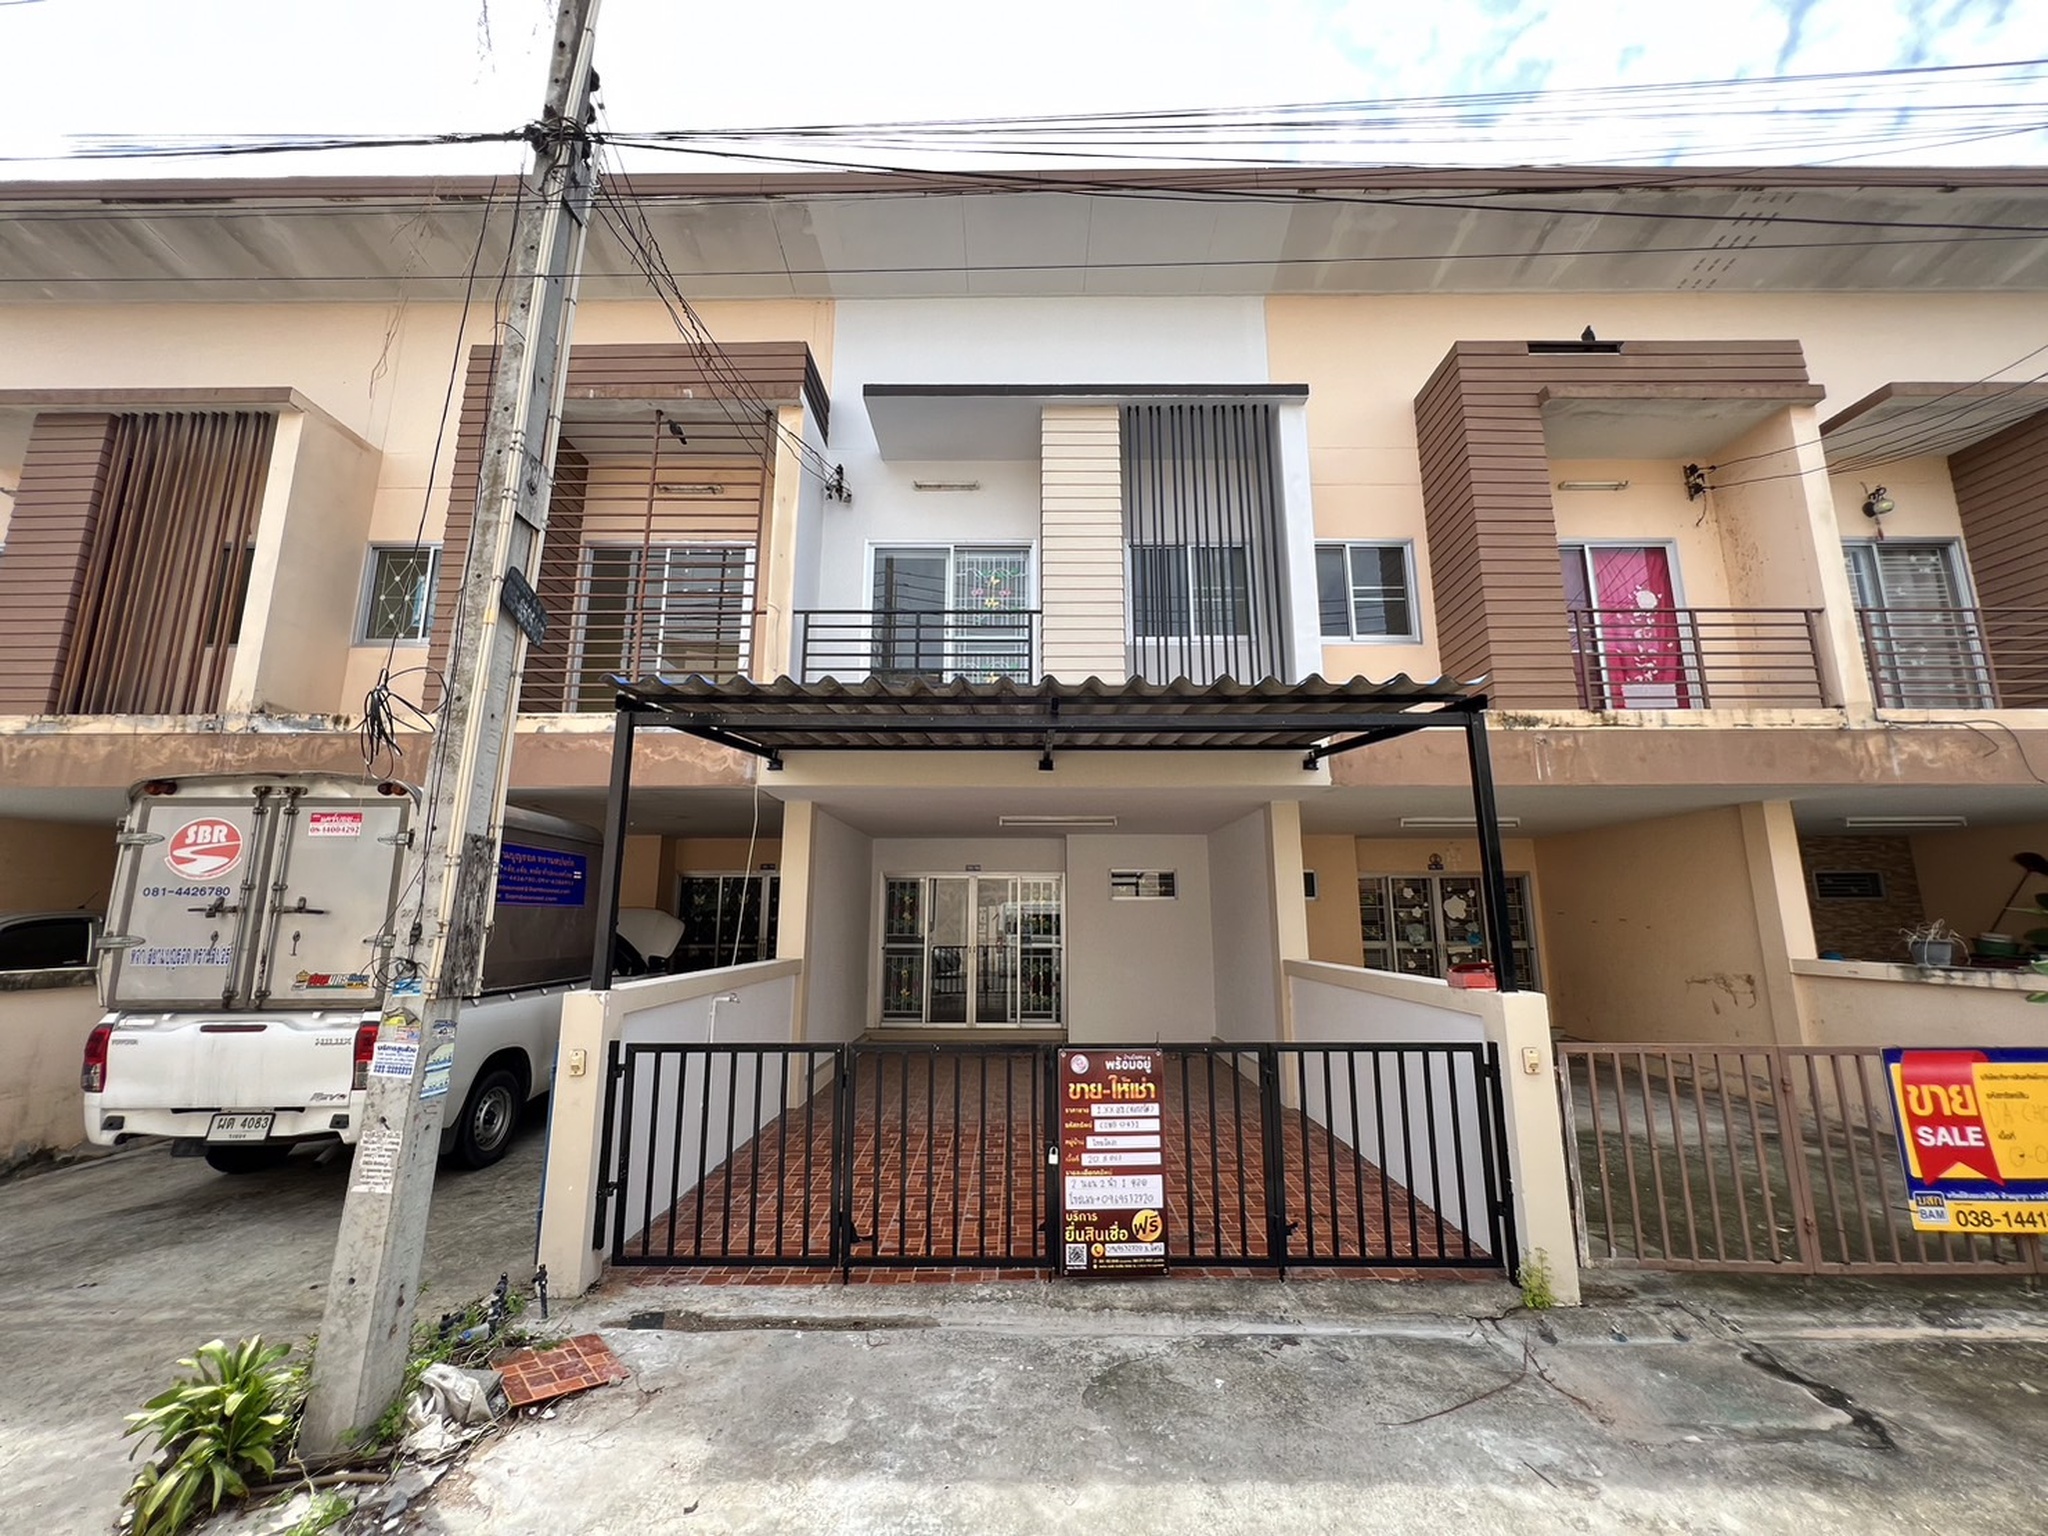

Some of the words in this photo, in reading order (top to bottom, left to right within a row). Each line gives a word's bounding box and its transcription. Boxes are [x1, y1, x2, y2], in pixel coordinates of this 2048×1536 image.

[184, 824, 229, 844] SBR
[143, 886, 231, 897] 081-4426780
[1104, 1055, 1152, 1074] พร้อมอยู่
[1905, 1084, 1979, 1116] ขาย
[240, 1117, 269, 1129] 4083
[1917, 1125, 1986, 1147] SALE
[1065, 1210, 1098, 1222] บริการ
[1134, 1211, 1159, 1235] ฟรี
[1919, 1208, 1946, 1220] BAM
[1955, 1210, 2048, 1228] 038-1441
[1065, 1221, 1129, 1241] ยื่นสินเชื่อ
